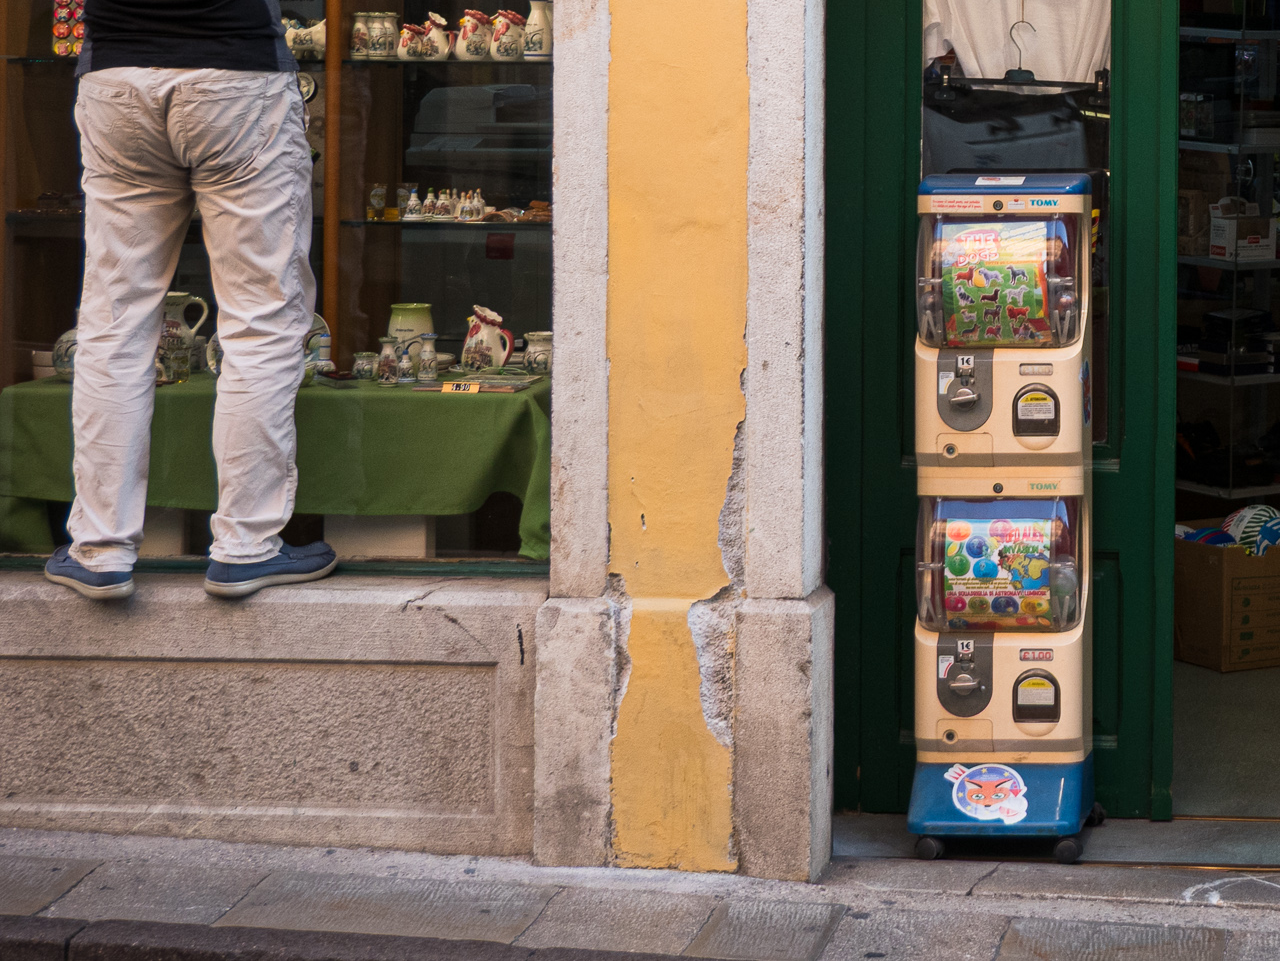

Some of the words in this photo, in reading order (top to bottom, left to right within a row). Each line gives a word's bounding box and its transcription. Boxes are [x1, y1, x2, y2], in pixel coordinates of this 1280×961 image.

[1029, 199, 1059, 207] TOMY
[960, 232, 996, 250] THE
[957, 247, 1000, 267] DOGS
[960, 357, 971, 366] 1€
[960, 641, 971, 650] 1€
[1022, 651, 1052, 660] £1.00
